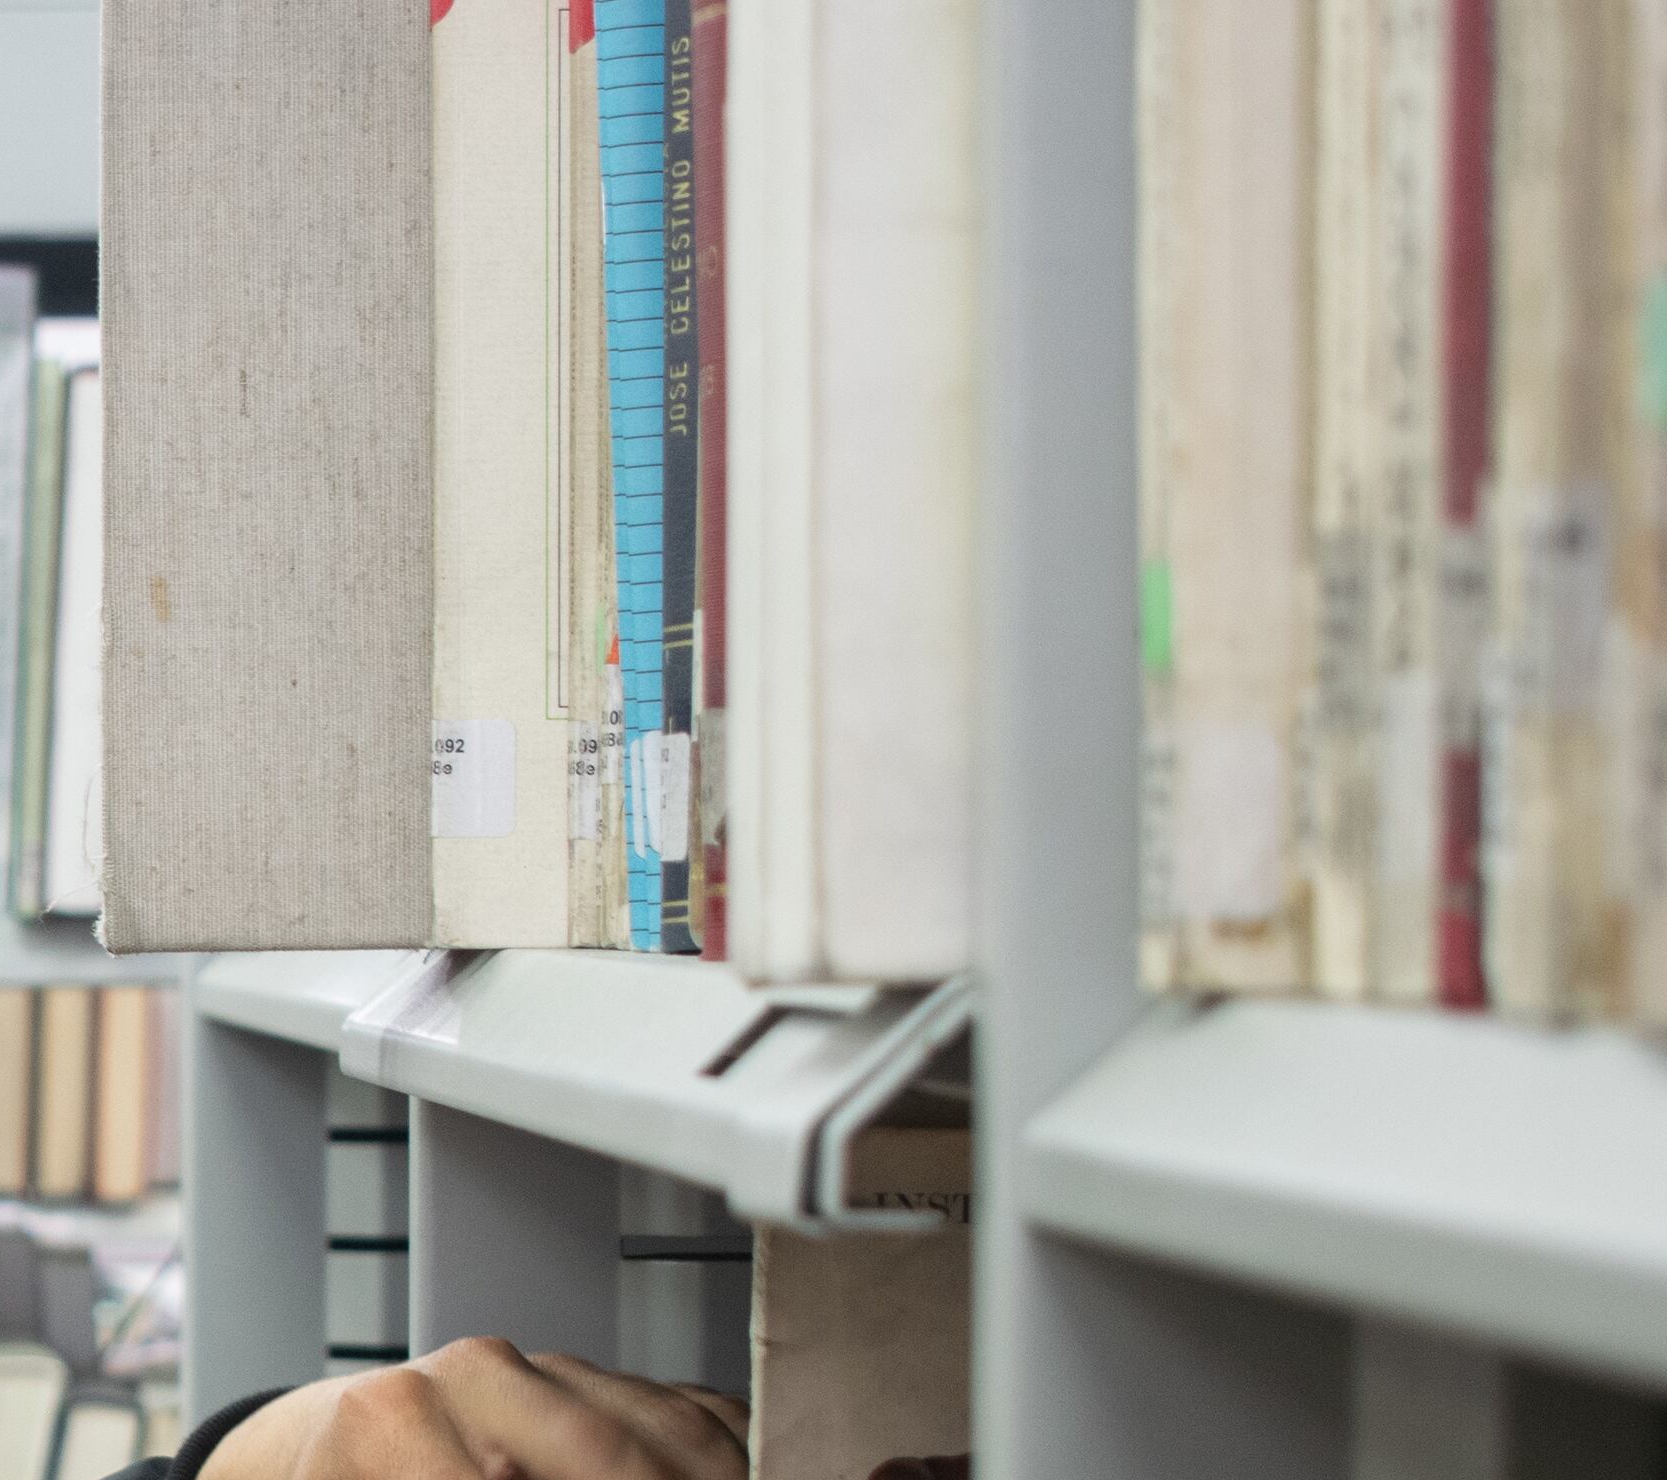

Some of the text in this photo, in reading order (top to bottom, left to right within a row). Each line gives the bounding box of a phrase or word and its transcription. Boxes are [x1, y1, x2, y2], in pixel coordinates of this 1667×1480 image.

[668, 36, 693, 436] JOSE CELESTINO MUTIS
